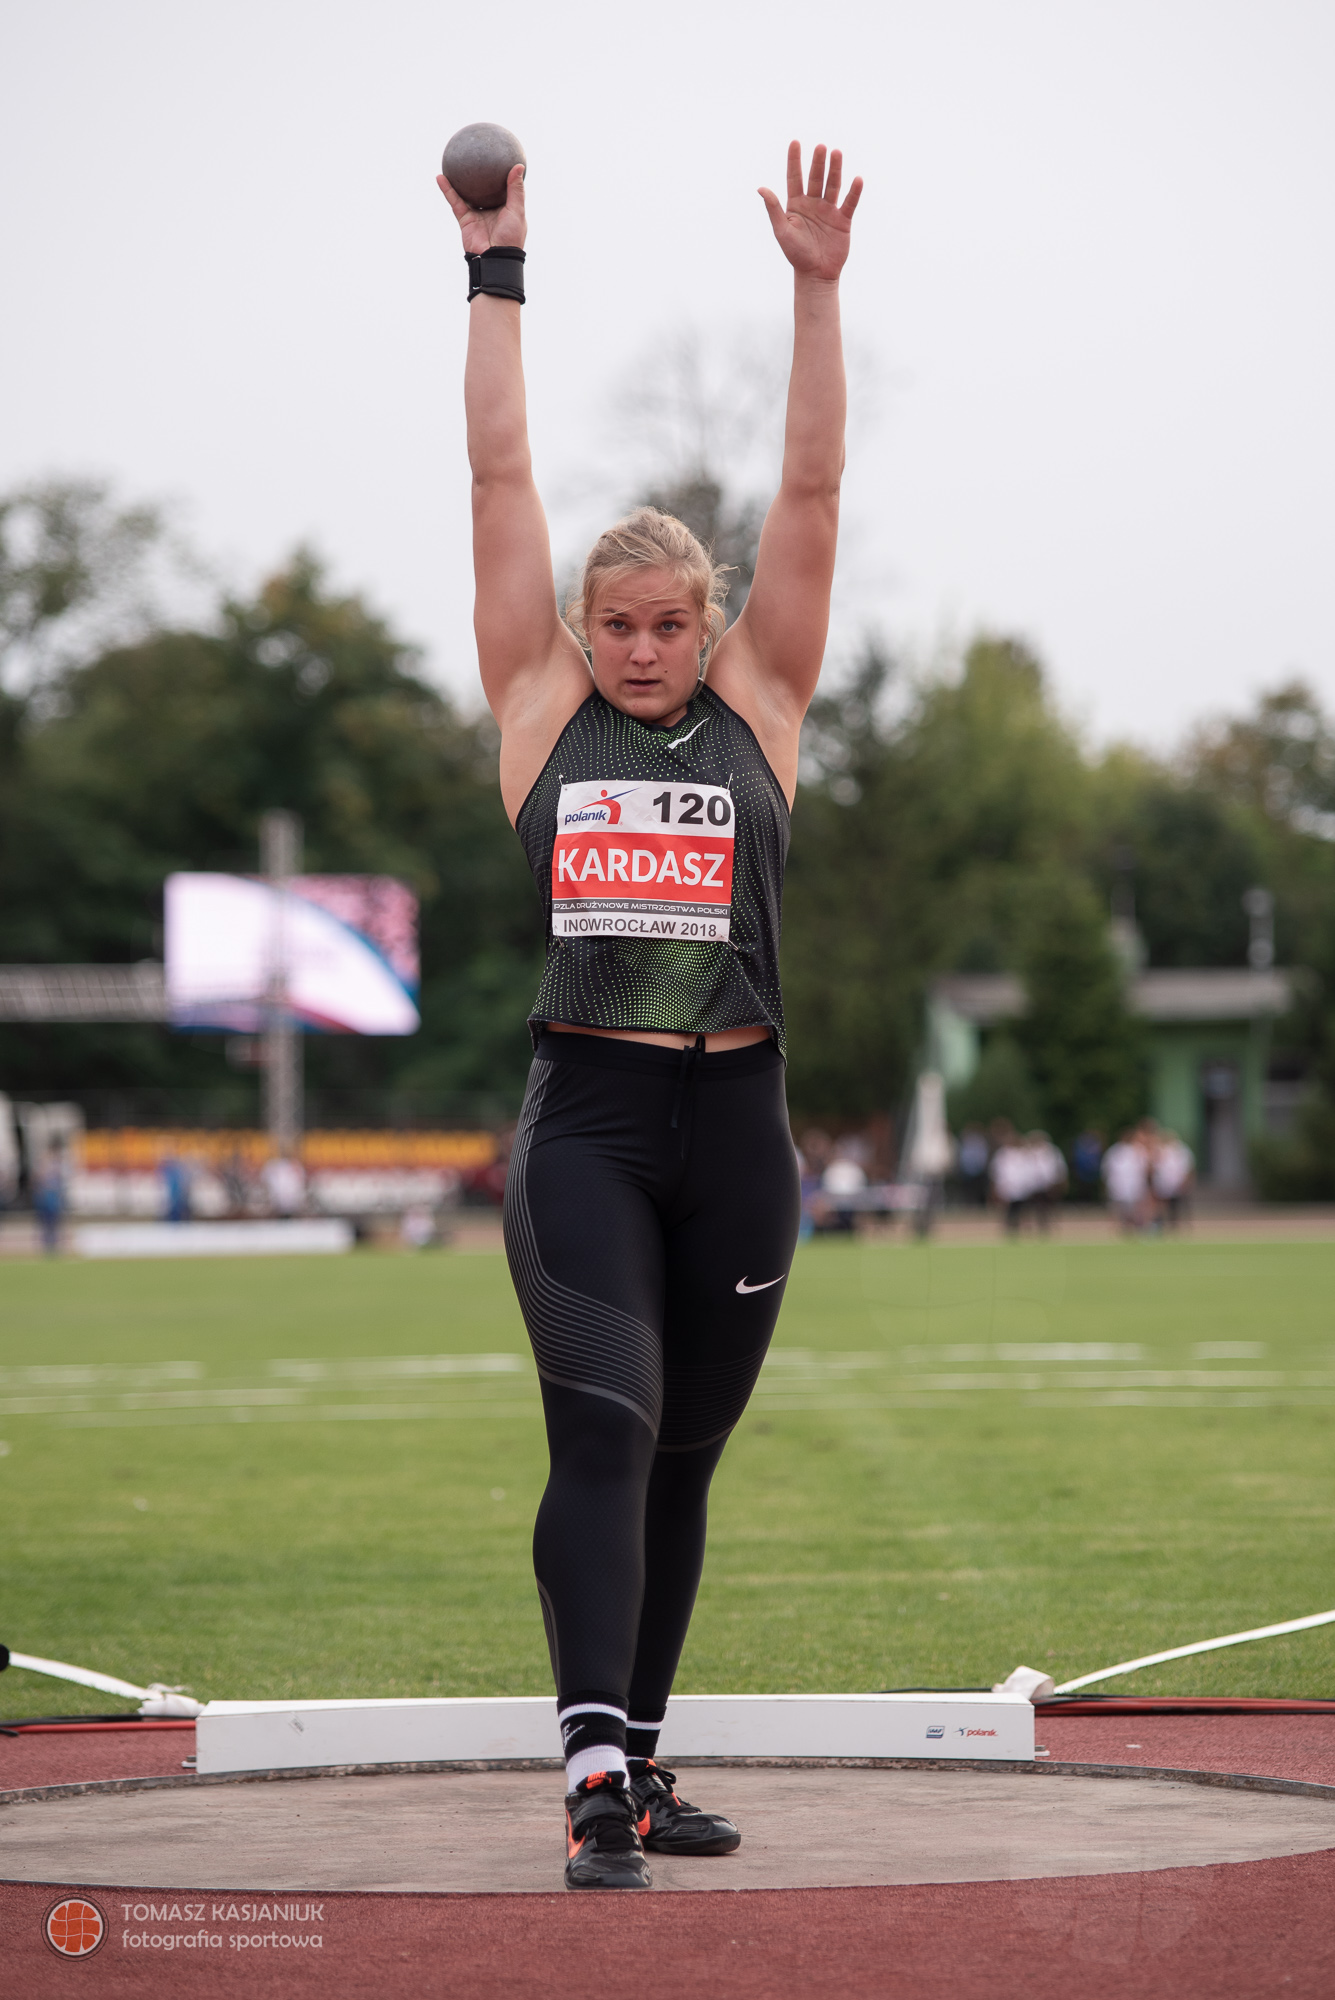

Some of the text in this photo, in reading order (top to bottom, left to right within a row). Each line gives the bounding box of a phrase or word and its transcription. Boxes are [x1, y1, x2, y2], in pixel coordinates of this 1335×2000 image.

[564, 809, 607, 826] polanik
[653, 791, 731, 826] 120
[557, 848, 726, 888] KARDASZ
[576, 901, 629, 909] DRUŻYNOWE
[631, 903, 696, 913] MISTRZOSTWA
[697, 907, 728, 915] POLSKI
[563, 918, 718, 938] INOWROCŁAW 2018
[587, 1770, 607, 1783] NIKE
